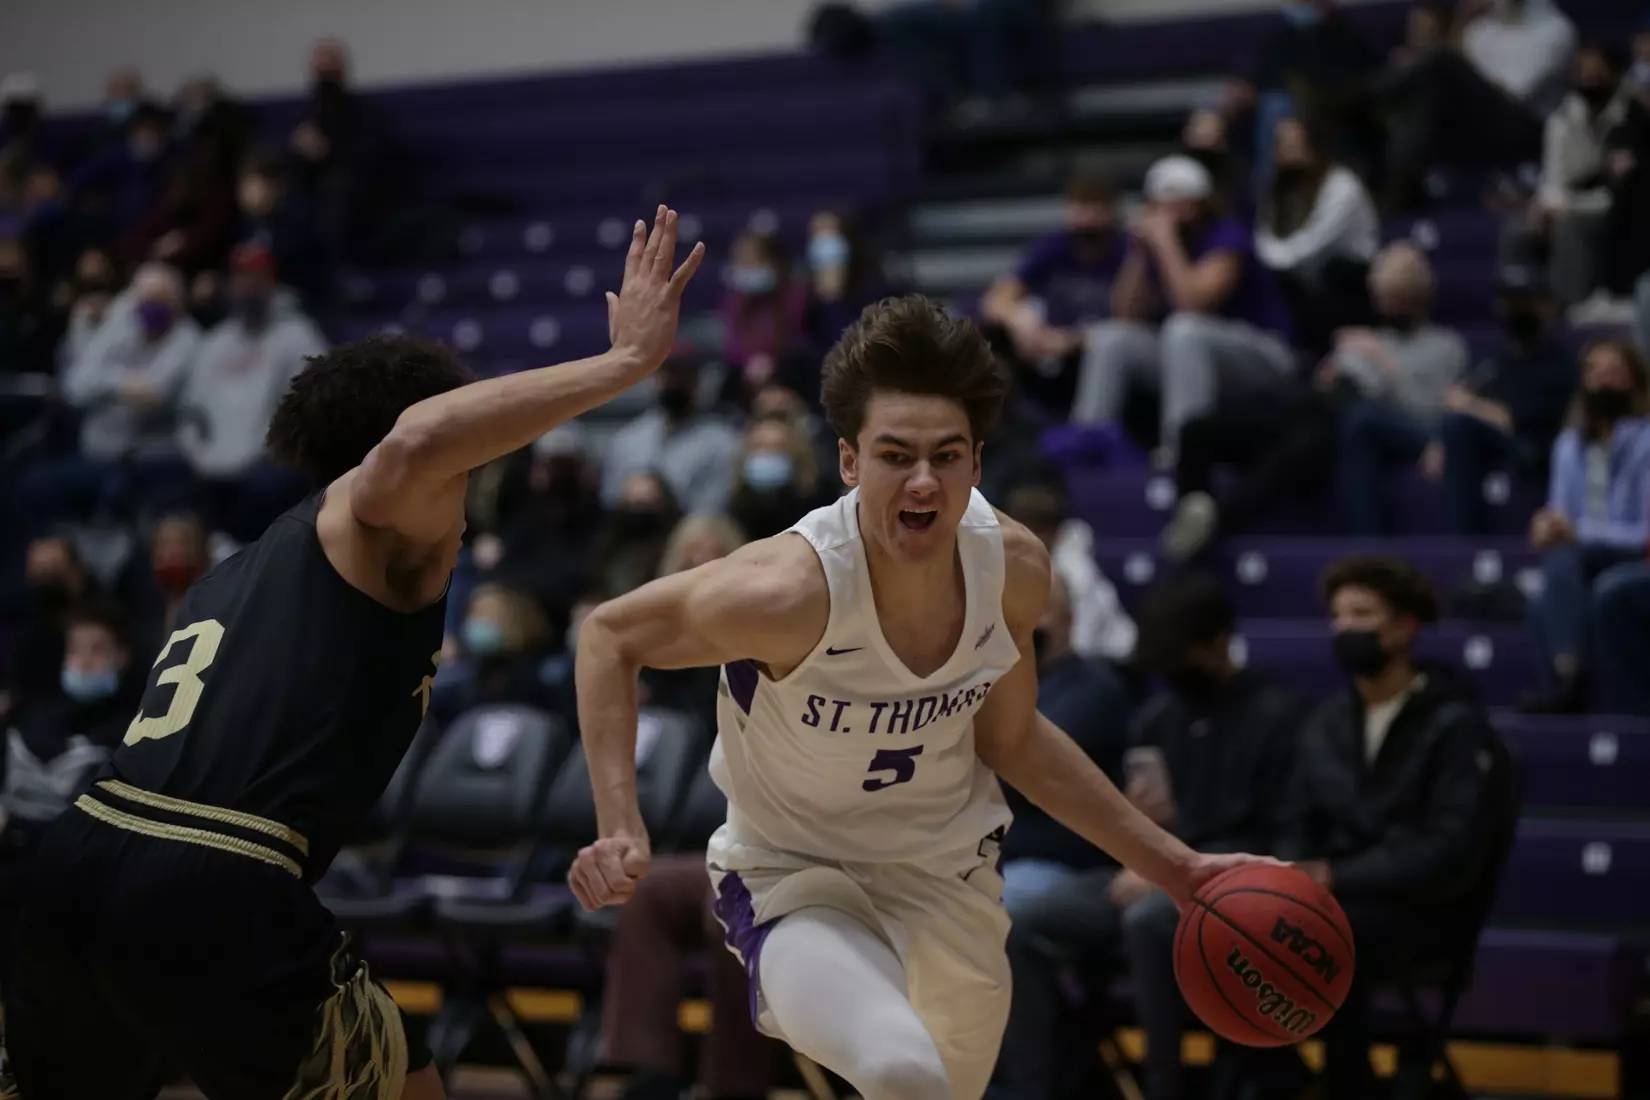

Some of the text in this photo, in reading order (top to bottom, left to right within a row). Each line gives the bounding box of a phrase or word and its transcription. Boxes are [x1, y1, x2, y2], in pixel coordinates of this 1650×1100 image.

[123, 618, 226, 747] 3
[801, 694, 851, 734] ST.
[862, 745, 924, 792] 5
[1270, 916, 1341, 985] NCAA
[1226, 947, 1316, 1033] Wilson
